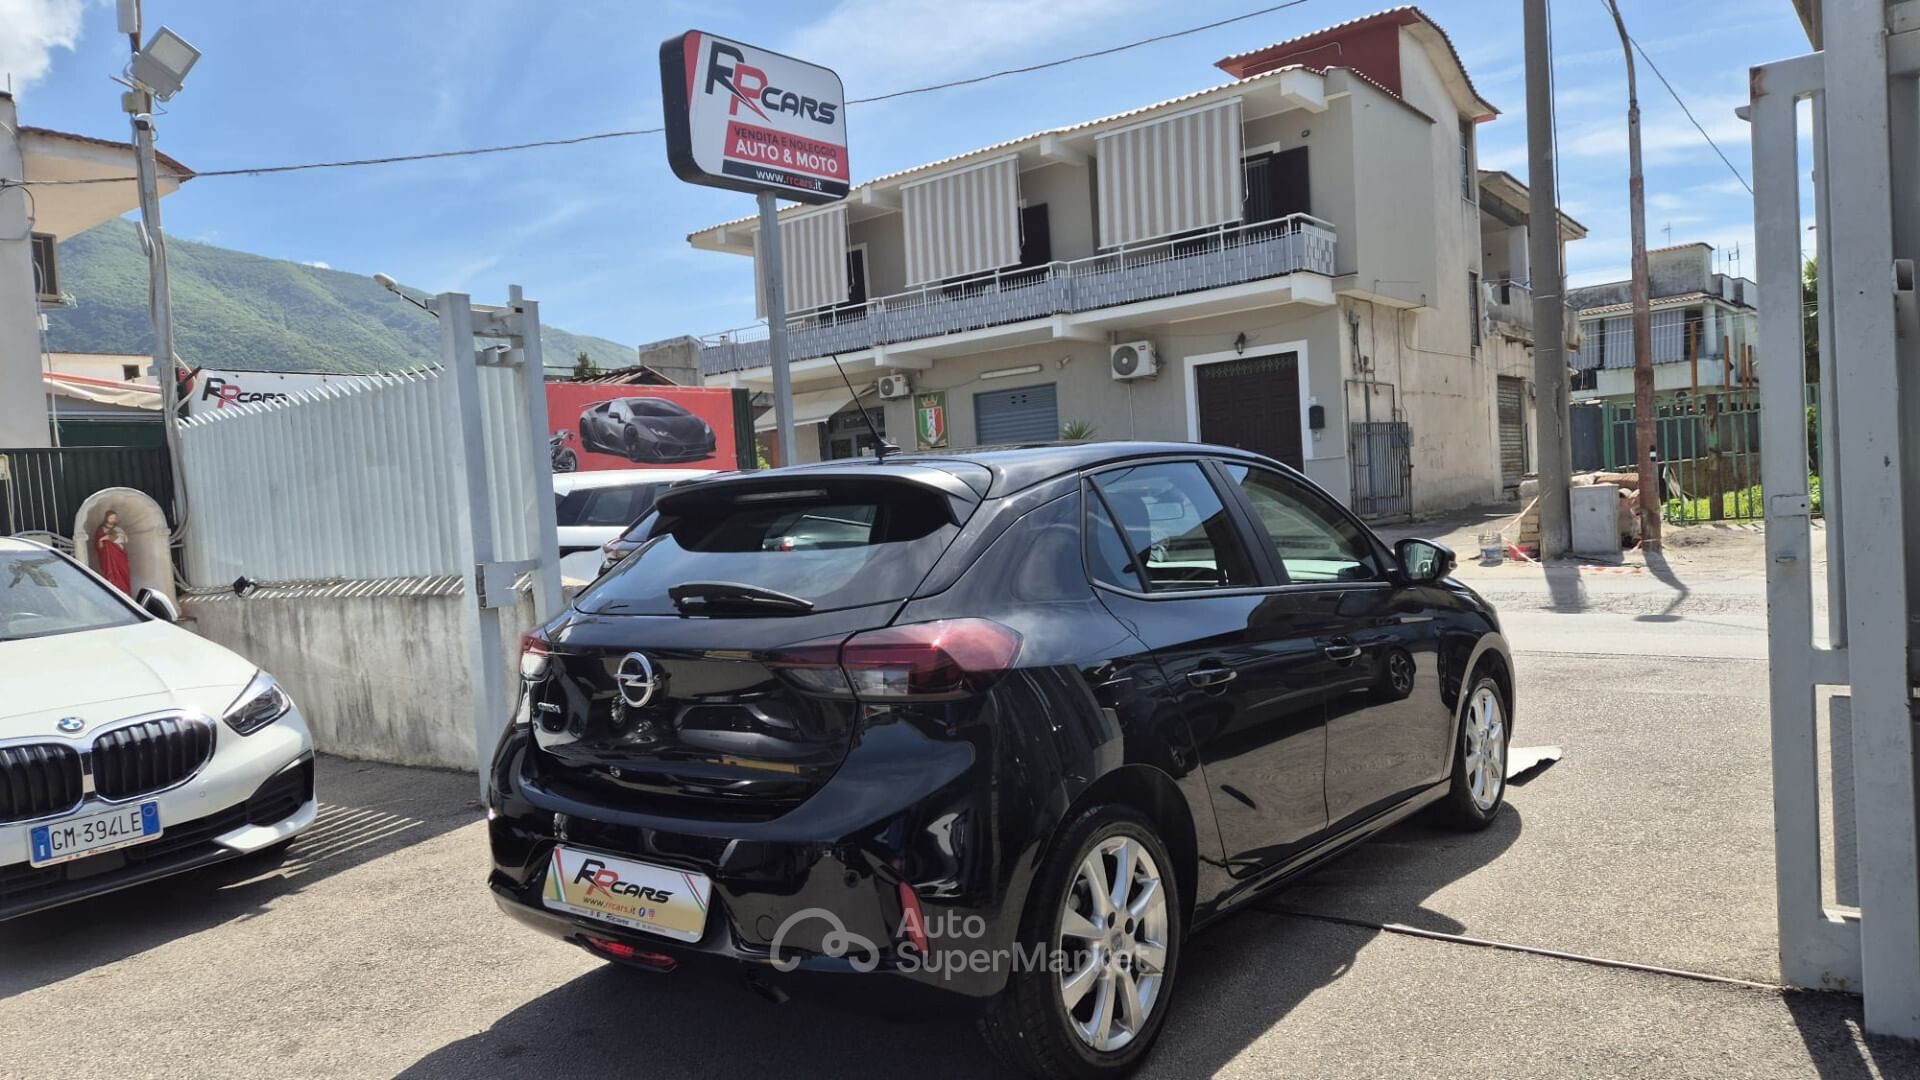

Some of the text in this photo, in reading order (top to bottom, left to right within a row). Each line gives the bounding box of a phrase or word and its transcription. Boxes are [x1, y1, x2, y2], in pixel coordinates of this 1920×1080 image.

[734, 127, 837, 158] VENDITA E NOLEGGIO
[735, 139, 838, 173] AUTO & MOTO
[755, 169, 823, 191] www.rrcars.it
[583, 896, 637, 915] www.rrcars.it
